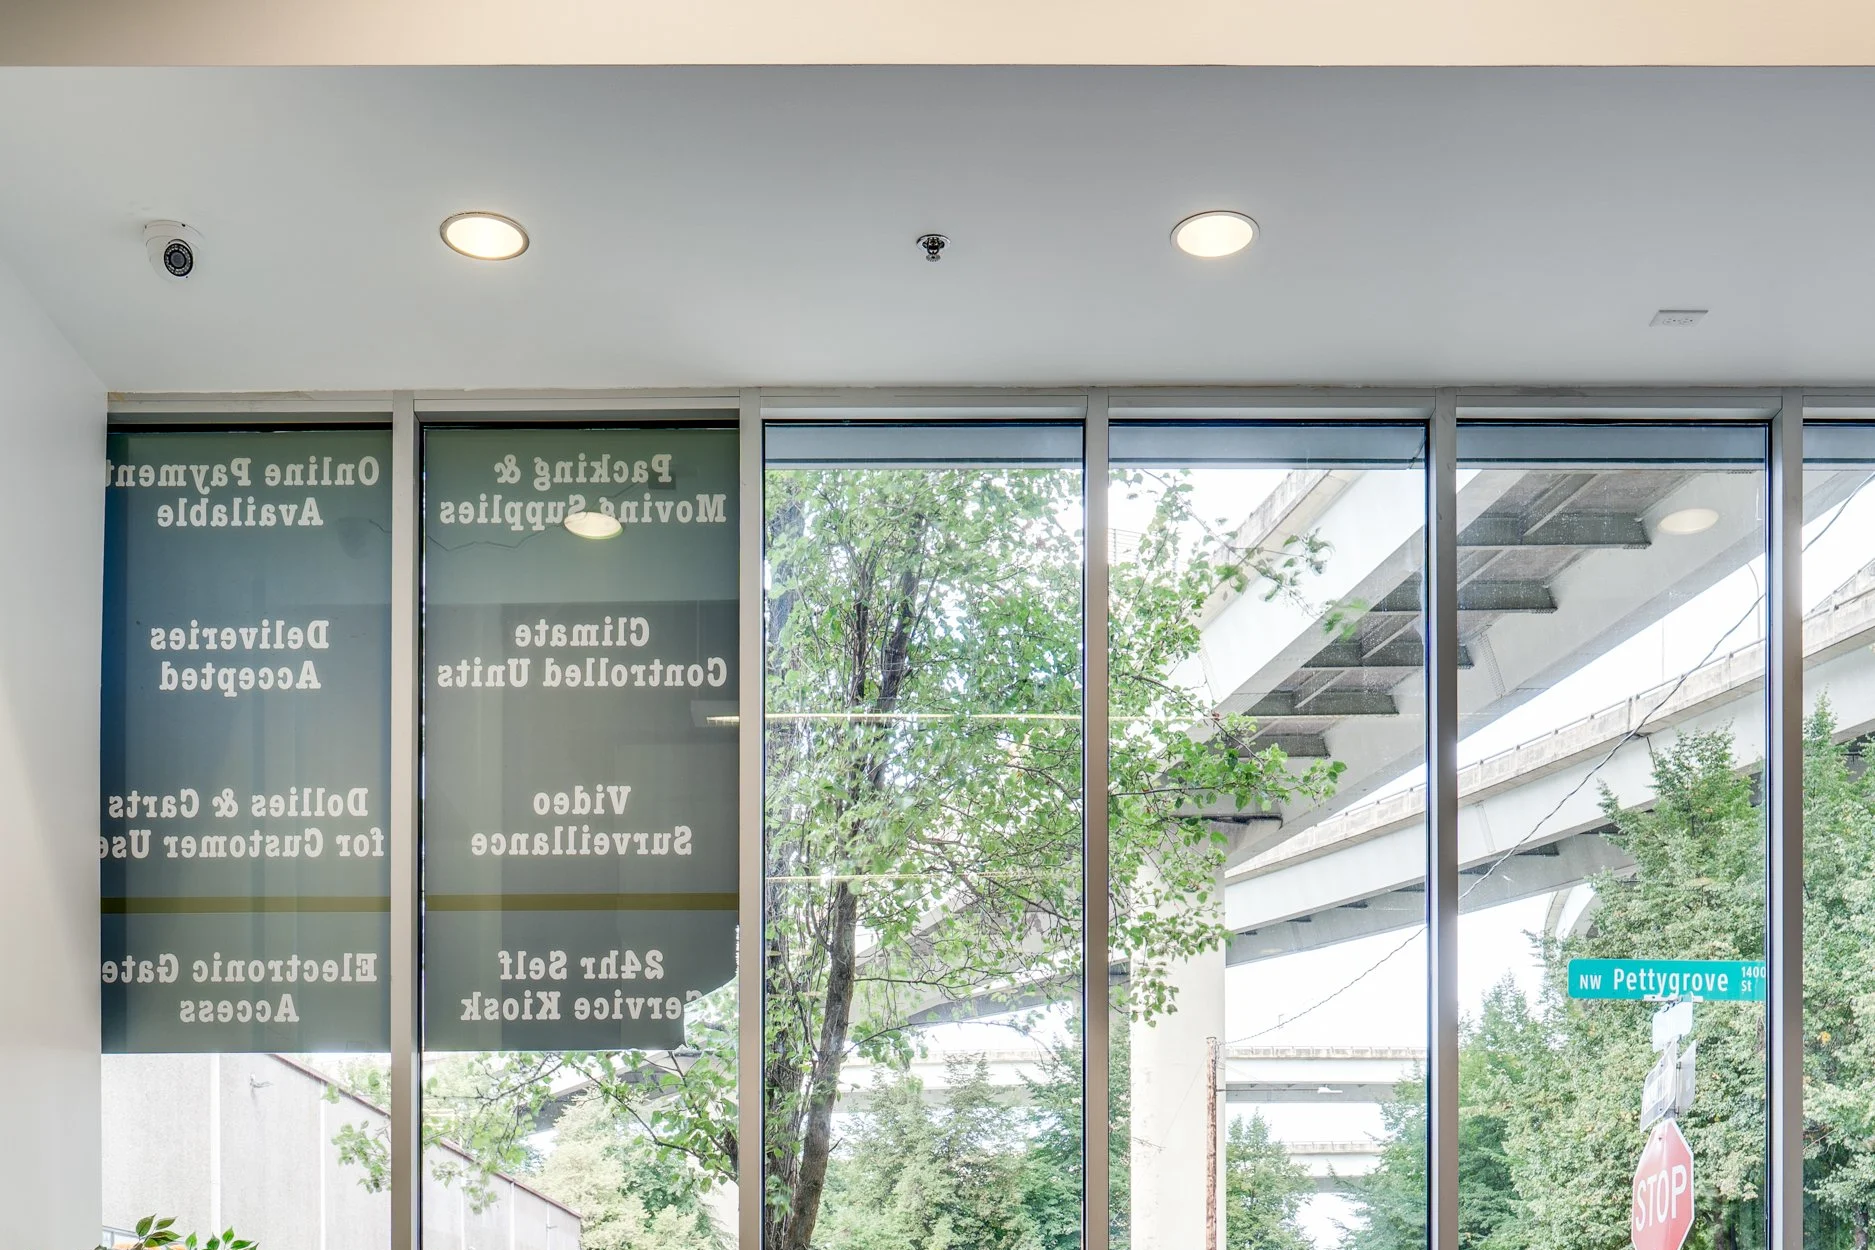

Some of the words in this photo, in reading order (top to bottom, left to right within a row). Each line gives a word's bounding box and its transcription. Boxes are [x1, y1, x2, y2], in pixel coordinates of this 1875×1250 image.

[1579, 974, 1602, 990] NW
[1614, 968, 1728, 996] Pettygrove
[1741, 980, 1752, 992] St
[1741, 966, 1766, 979] 1400
[1635, 1164, 1688, 1232] STOP
